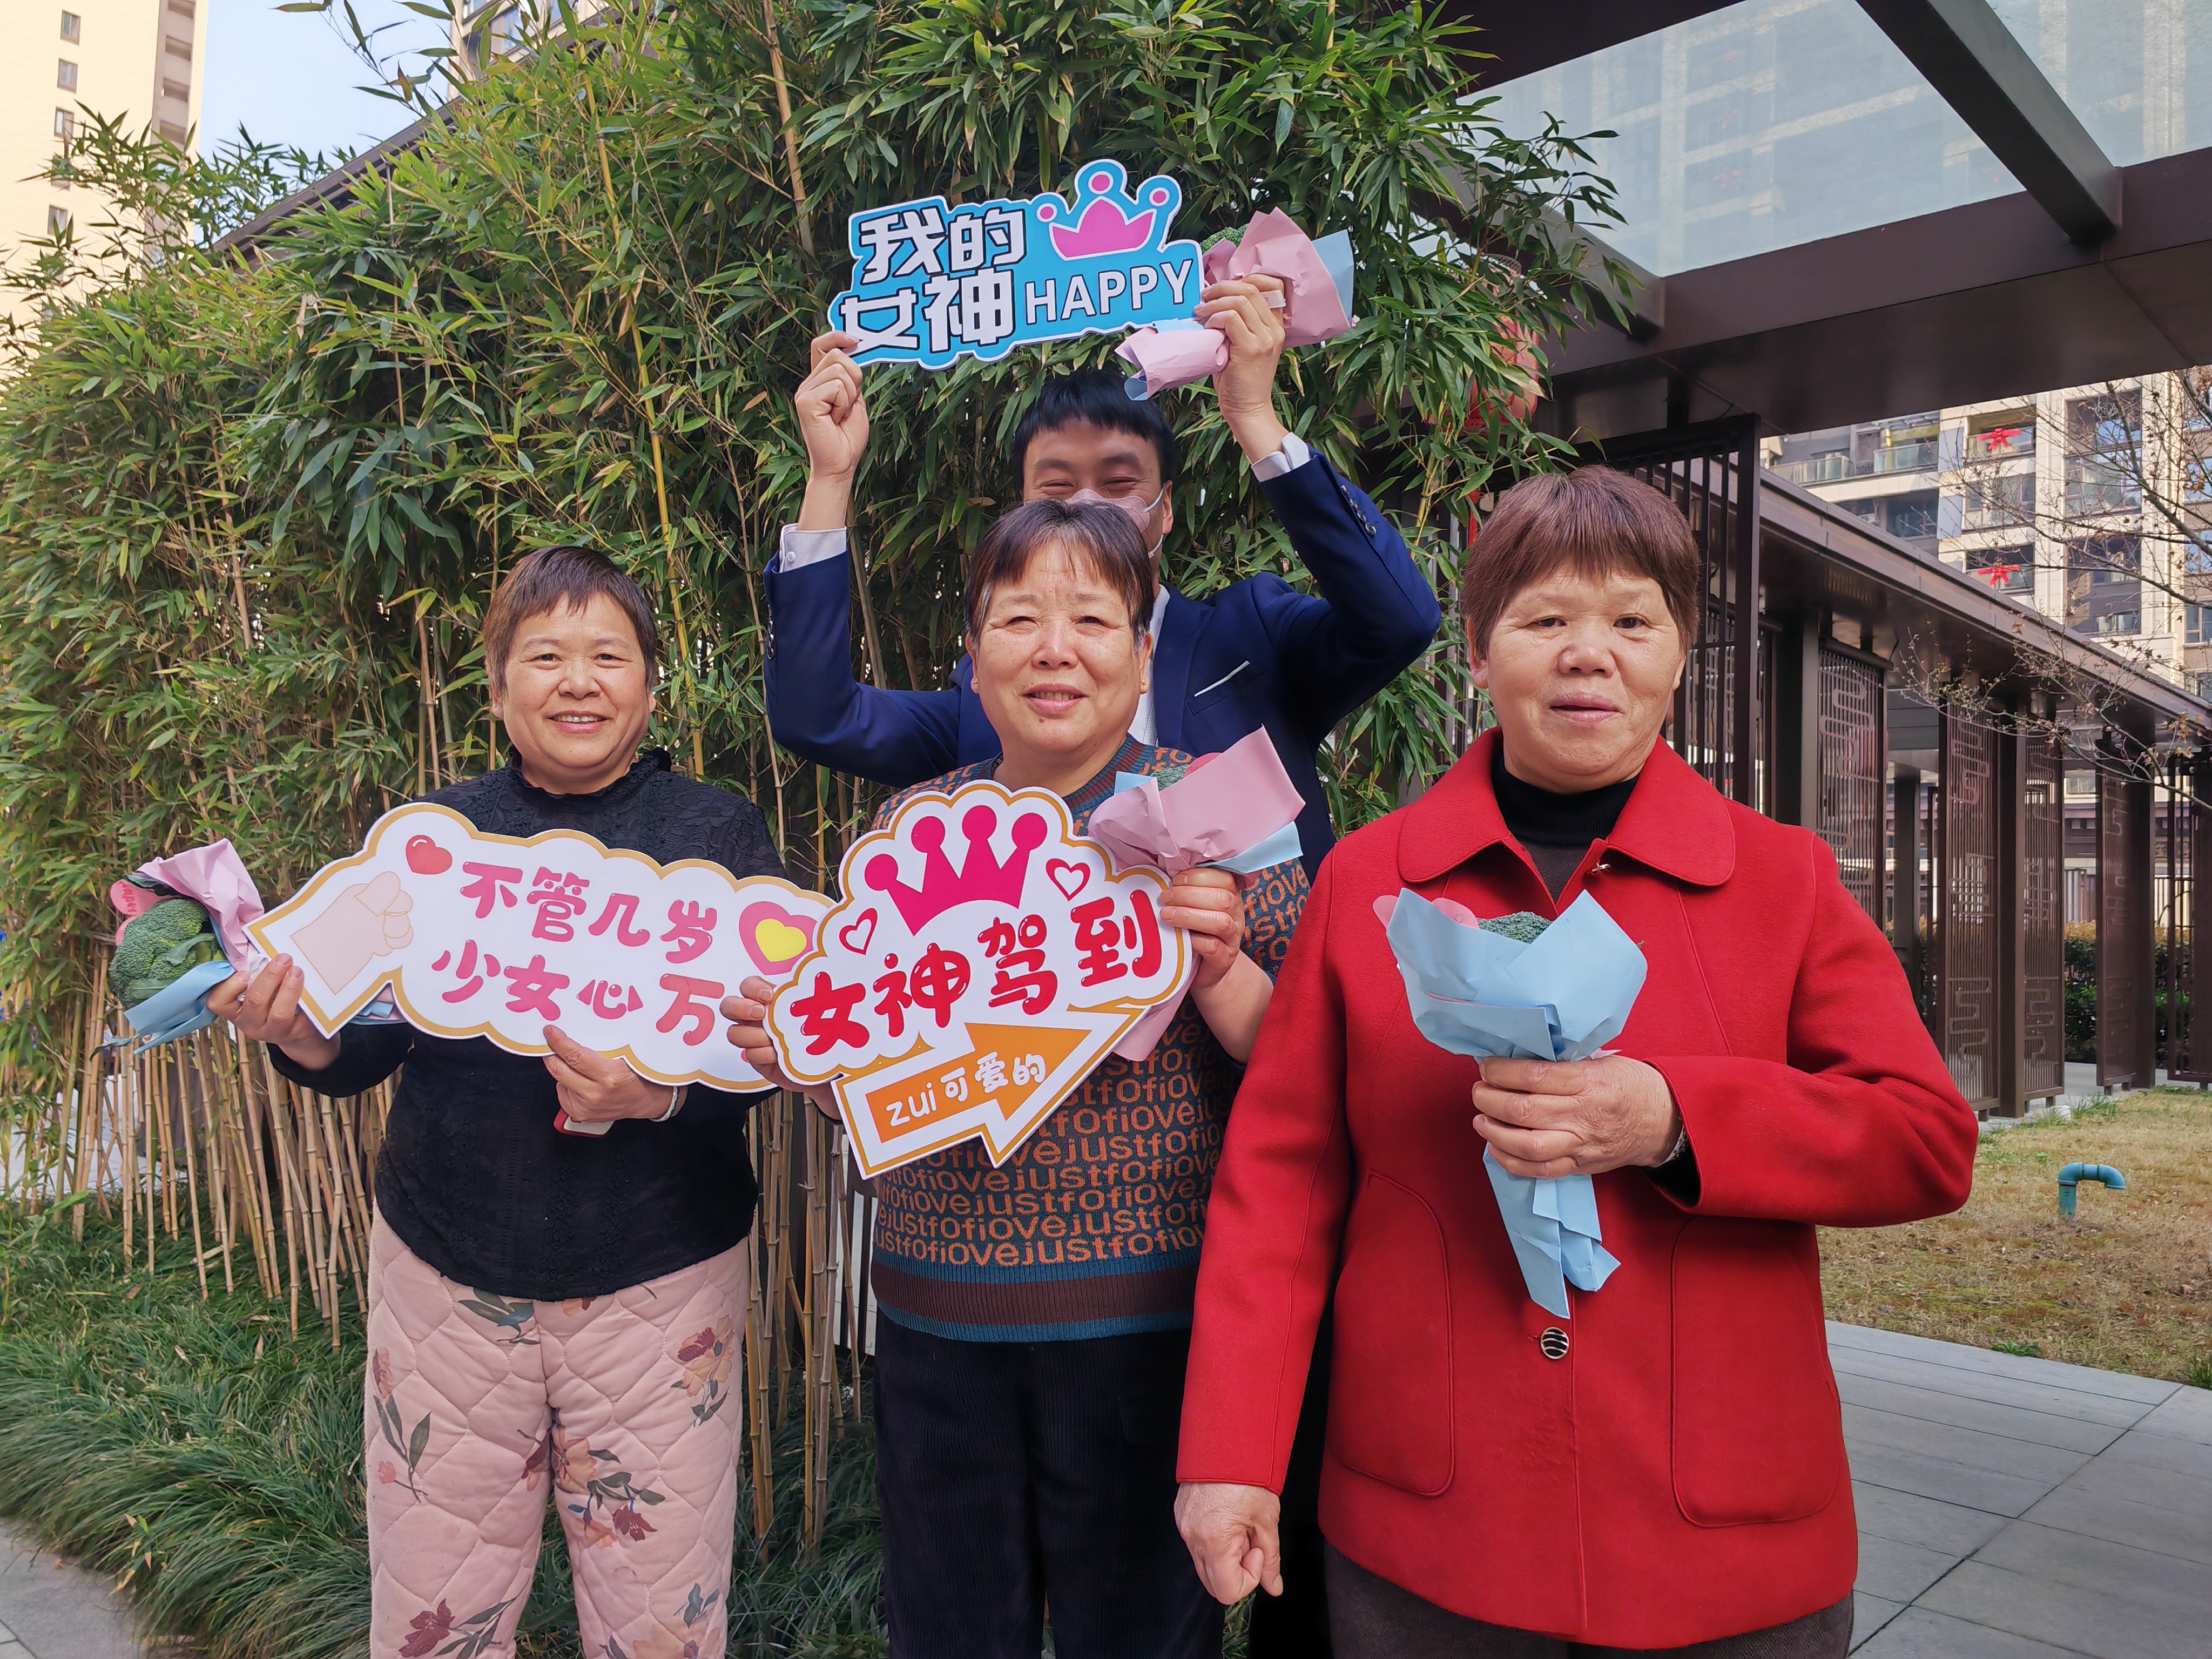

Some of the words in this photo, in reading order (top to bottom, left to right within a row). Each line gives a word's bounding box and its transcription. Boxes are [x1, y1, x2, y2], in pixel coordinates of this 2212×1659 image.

[860, 207, 1027, 285] 我的
[1025, 259, 1193, 325] HAPPY
[839, 268, 1015, 355] 女神
[460, 861, 718, 965] 不管几岁
[432, 939, 750, 1063] 少女心万
[790, 889, 1163, 1055] 女神驾到
